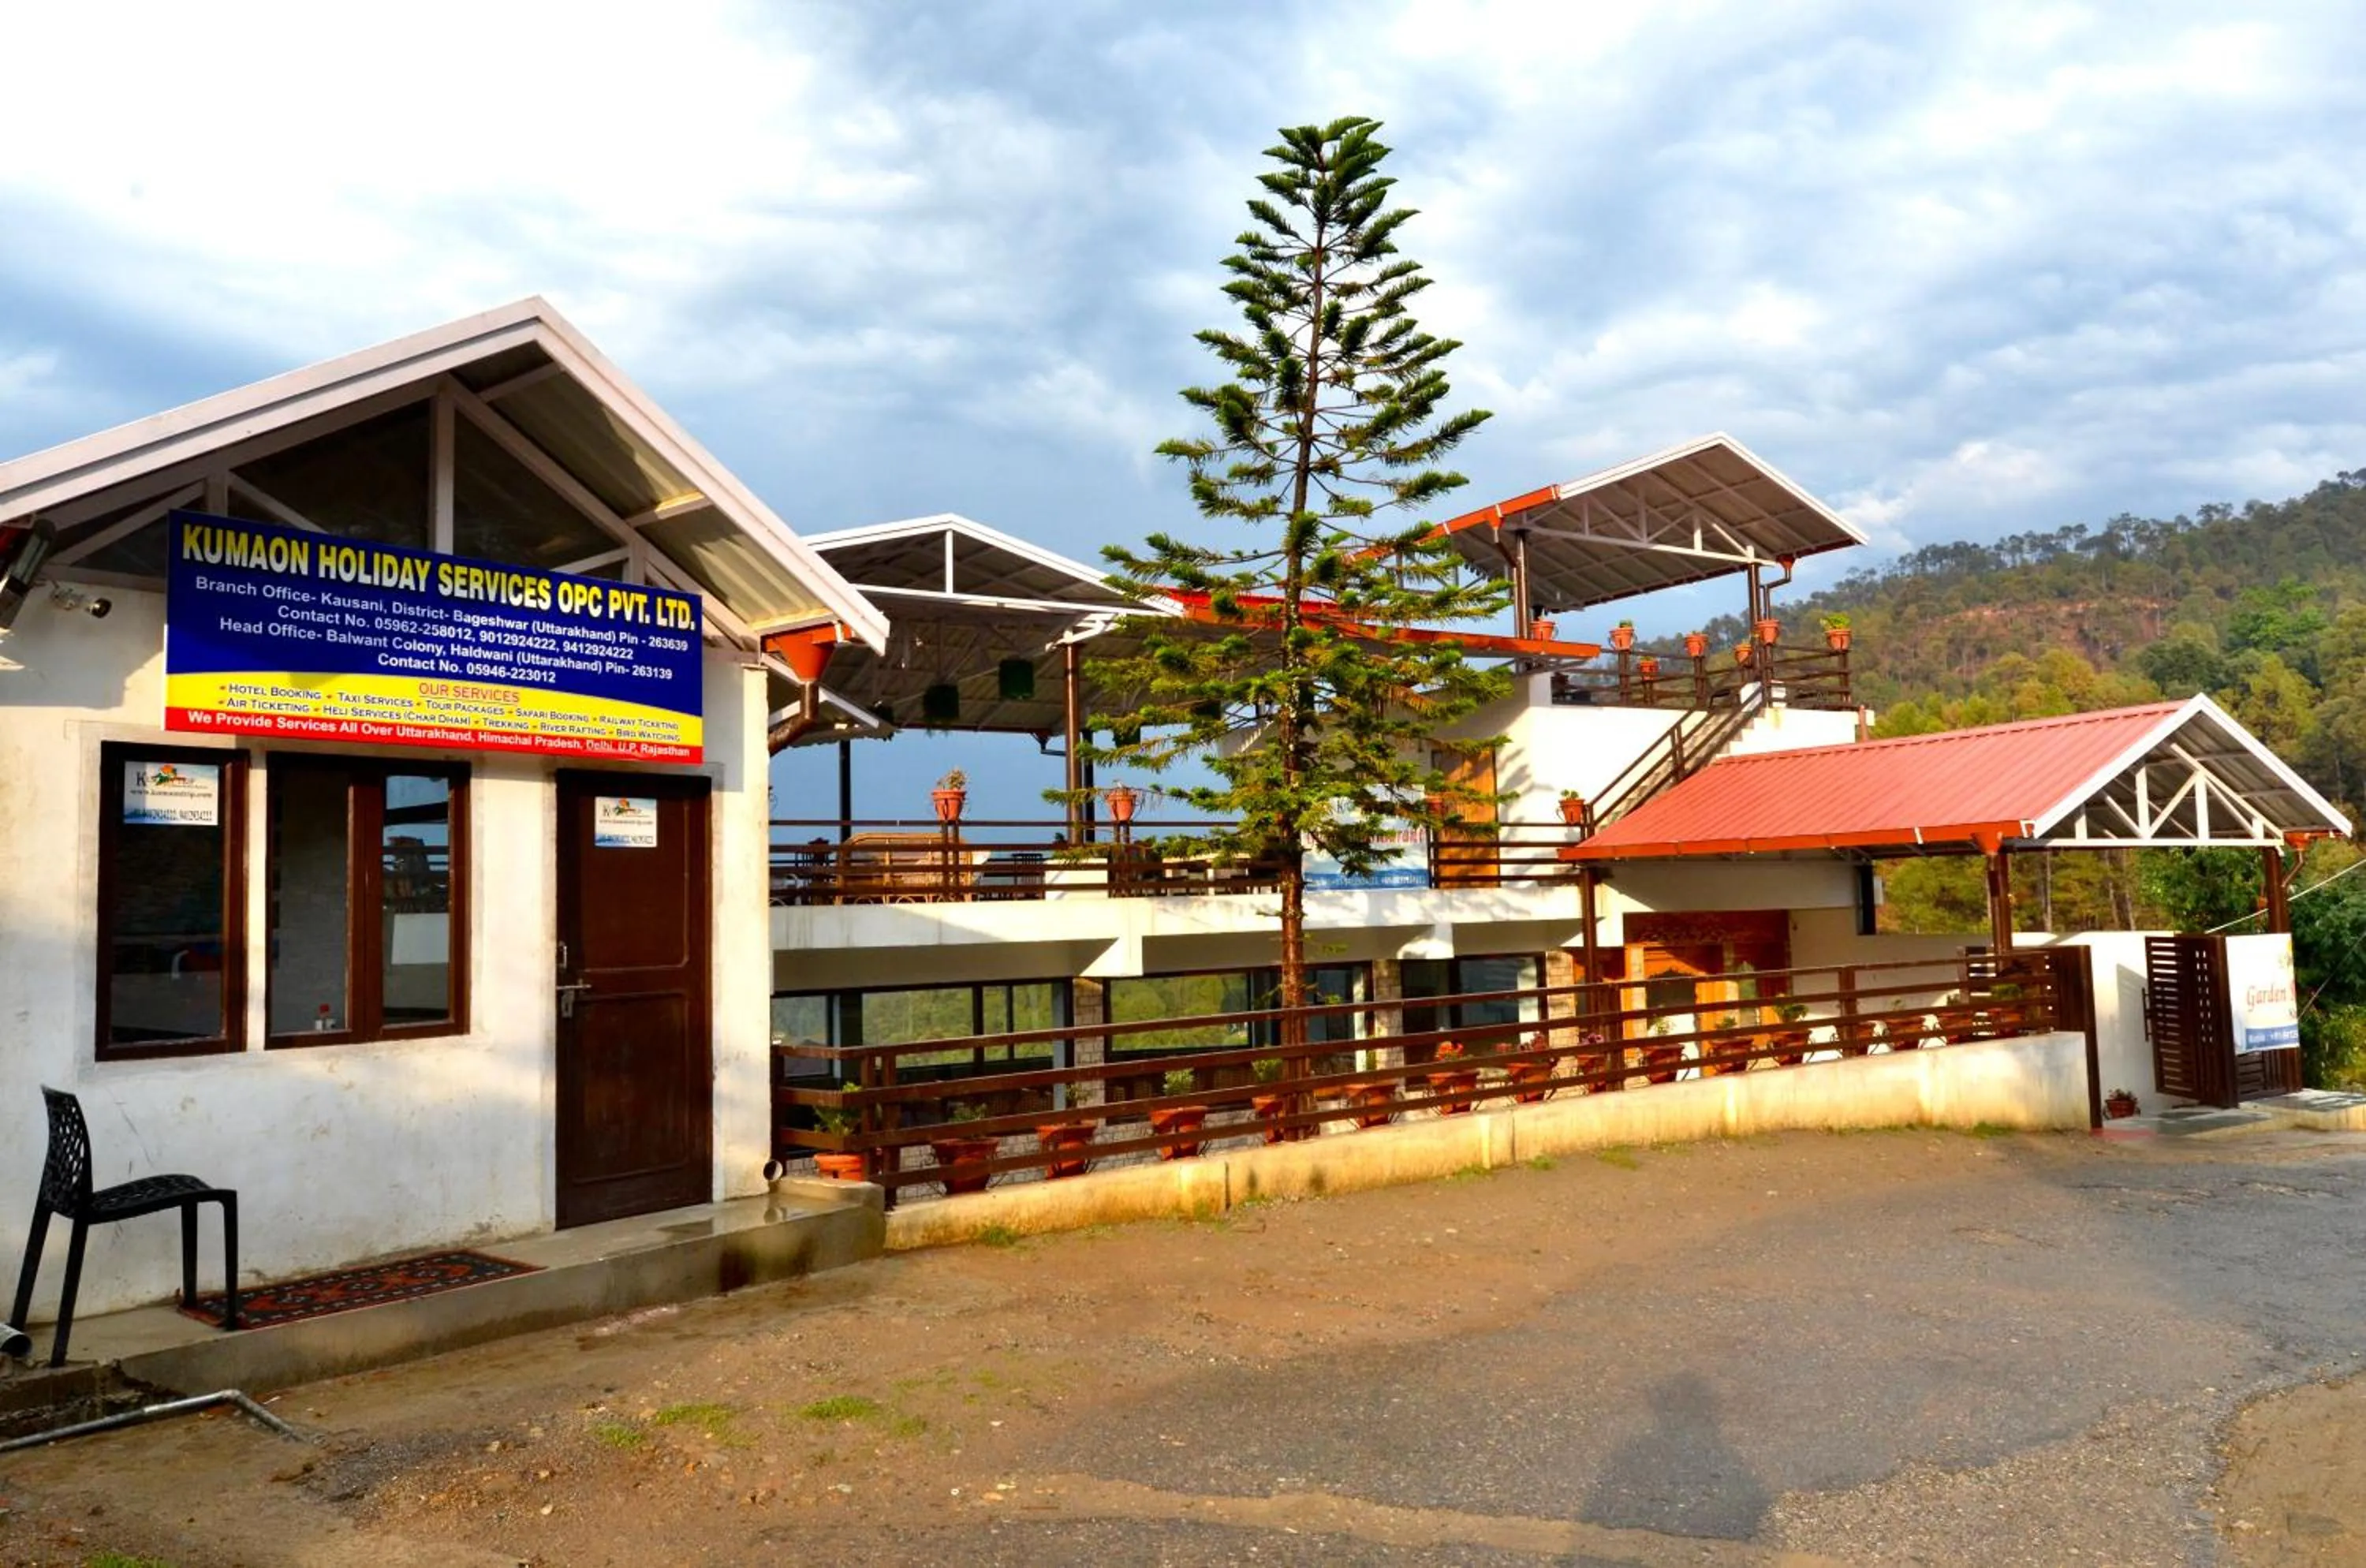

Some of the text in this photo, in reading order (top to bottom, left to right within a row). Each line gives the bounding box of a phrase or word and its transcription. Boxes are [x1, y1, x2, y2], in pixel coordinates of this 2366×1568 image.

[182, 524, 696, 630] KUMAON HOLIDAY SERVICES OPC PVT. LTD.
[196, 576, 257, 595] Branch
[263, 584, 316, 602] Office-
[321, 592, 387, 614] Kausani,
[392, 602, 450, 619] District-
[453, 610, 529, 630] Bageshwar
[532, 621, 616, 644] (Uttarakhand)
[619, 633, 638, 644] Pin
[220, 617, 263, 634] Head
[268, 622, 322, 640] Office-
[327, 629, 388, 648] Balwant
[392, 637, 446, 656] Colony,
[450, 644, 513, 662] Haldwani
[517, 651, 603, 675] (Uttarakhand)
[632, 665, 673, 680] 263139
[278, 606, 340, 625] Contact
[345, 613, 370, 628] No.
[563, 641, 634, 659] 9412924222
[378, 653, 556, 683] Contact No. 05946-223012
[229, 683, 267, 696] HOTEL
[271, 687, 321, 700] BOOKING
[338, 693, 360, 703] TAXI
[364, 695, 413, 707] SERVICES
[426, 700, 452, 710] TOUR
[454, 703, 505, 715] PACKAGES
[550, 711, 589, 722] BOOKING
[599, 715, 636, 726] RAILWAY
[419, 682, 521, 703] OUR SERVICES
[188, 711, 212, 724] We
[216, 712, 272, 727] Provide
[277, 717, 336, 731] Services
[339, 721, 357, 734] All
[361, 723, 393, 736] Over
[396, 726, 475, 743] Uttarakhand,
[478, 732, 532, 745] Himachal
[640, 744, 690, 756] Rajasthan
[227, 697, 247, 707] AIR
[251, 700, 309, 713] TICKETING
[351, 707, 401, 720] SERVICES
[483, 718, 528, 730] TREKKING
[540, 722, 566, 732] RIVER
[569, 726, 606, 735] RAFTING
[2246, 984, 2287, 1012] Garden
